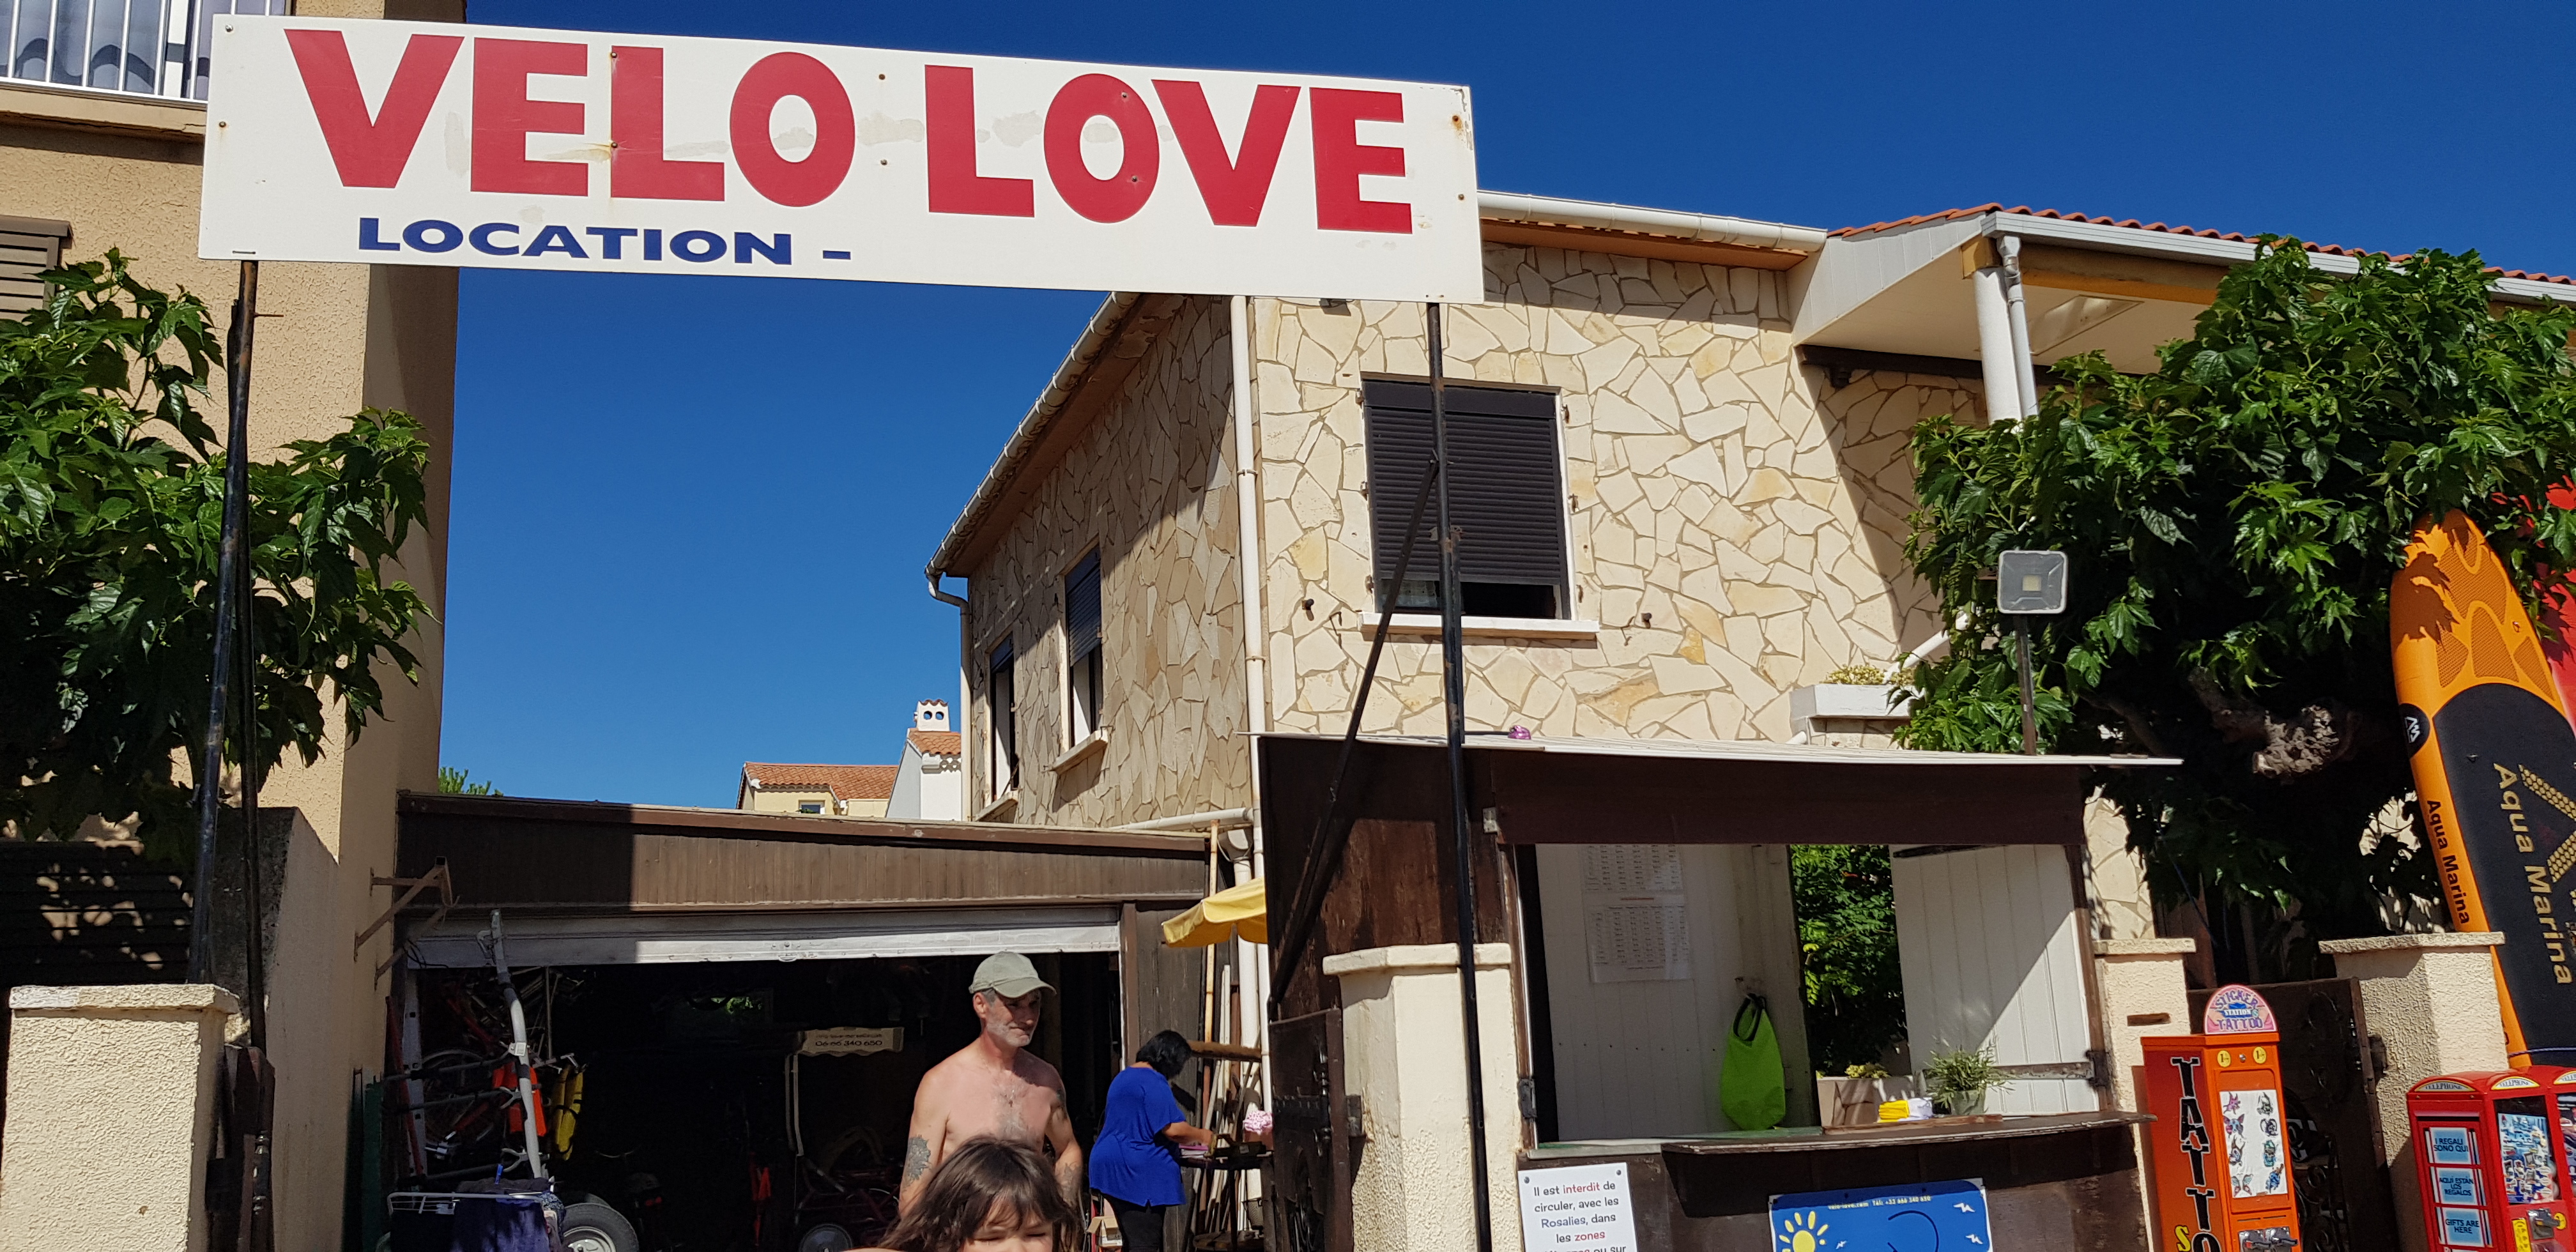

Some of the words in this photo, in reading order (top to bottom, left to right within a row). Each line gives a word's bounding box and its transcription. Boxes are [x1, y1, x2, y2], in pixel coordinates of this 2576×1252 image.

[284, 29, 855, 208] VELO
[924, 64, 1413, 234] LOVE
[358, 217, 792, 265] LOCATION
[2427, 800, 2448, 850] Aqua
[2442, 855, 2471, 924] Marina
[2493, 763, 2534, 853] Aqua
[2524, 865, 2573, 984] Marina
[2216, 1017, 2264, 1030] TATTOO
[1543, 1186, 1560, 1196] est
[1563, 1182, 1600, 1194] interdit
[1603, 1180, 1616, 1190] de
[1535, 1201, 1575, 1212] circuler,
[1579, 1199, 1602, 1209] avec
[1604, 1197, 1619, 1206] les
[1541, 1216, 1588, 1228] Rosalies,
[1591, 1214, 1616, 1223] dans
[1556, 1233, 1571, 1243] les
[1574, 1231, 1606, 1241] zones
